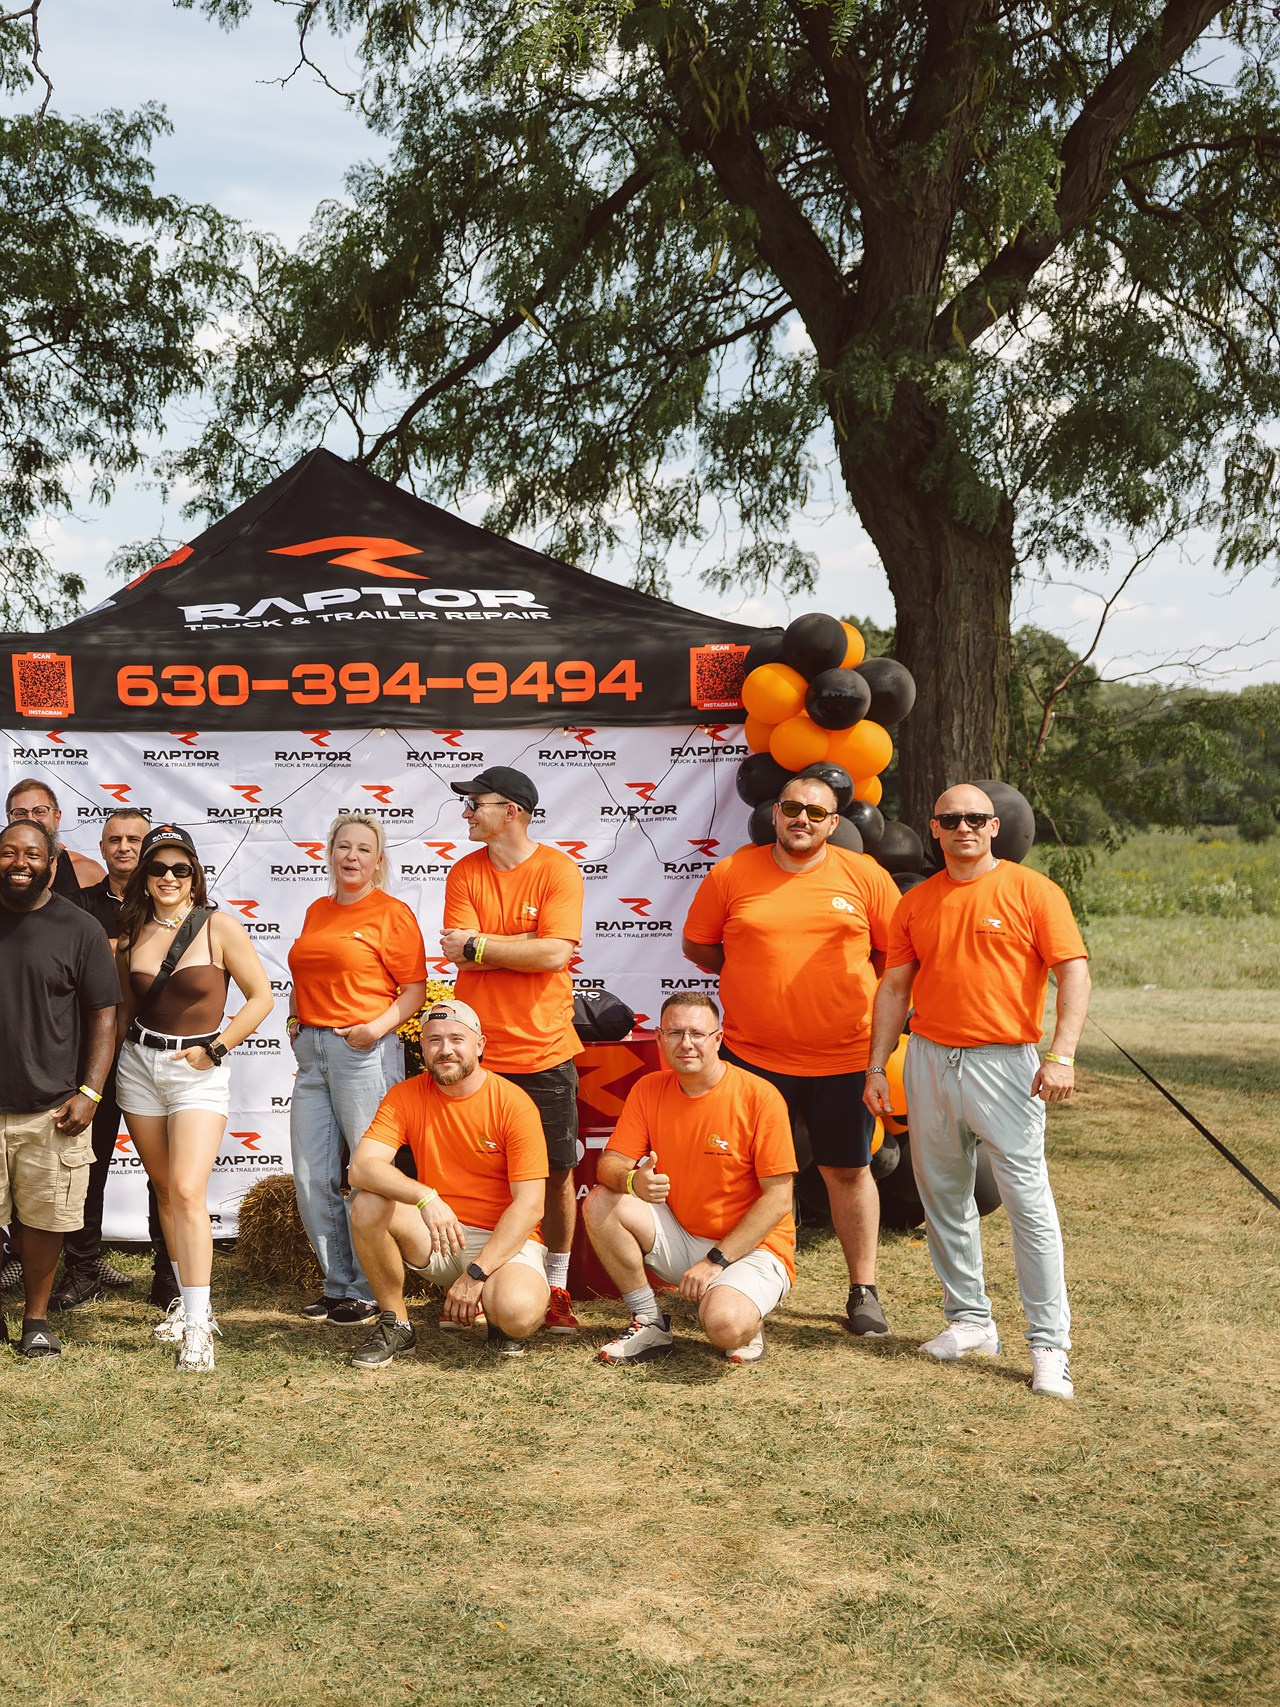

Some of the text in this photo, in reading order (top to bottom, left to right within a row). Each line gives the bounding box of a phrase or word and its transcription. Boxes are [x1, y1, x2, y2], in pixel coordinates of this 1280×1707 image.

[177, 587, 549, 622] RAPTOR
[290, 616, 311, 626] &
[316, 610, 438, 623] TRAILER
[444, 610, 551, 621] REPAIR
[116, 659, 644, 707] 630-394-9494
[13, 748, 88, 759] RAPTOR
[143, 750, 219, 761] RAPTOR
[274, 751, 351, 761] RAPTOR
[406, 751, 484, 761] RAPTOR
[538, 750, 616, 760] RAPTOR
[670, 744, 748, 757] RAPTOR
[207, 808, 283, 818] RAPTOR
[600, 805, 677, 816] RAPTOR
[401, 865, 452, 875] RAPT
[664, 862, 716, 873] RAPT
[244, 923, 281, 933] TOR
[595, 920, 672, 931] RAPTOR
[572, 979, 606, 989] TOR
